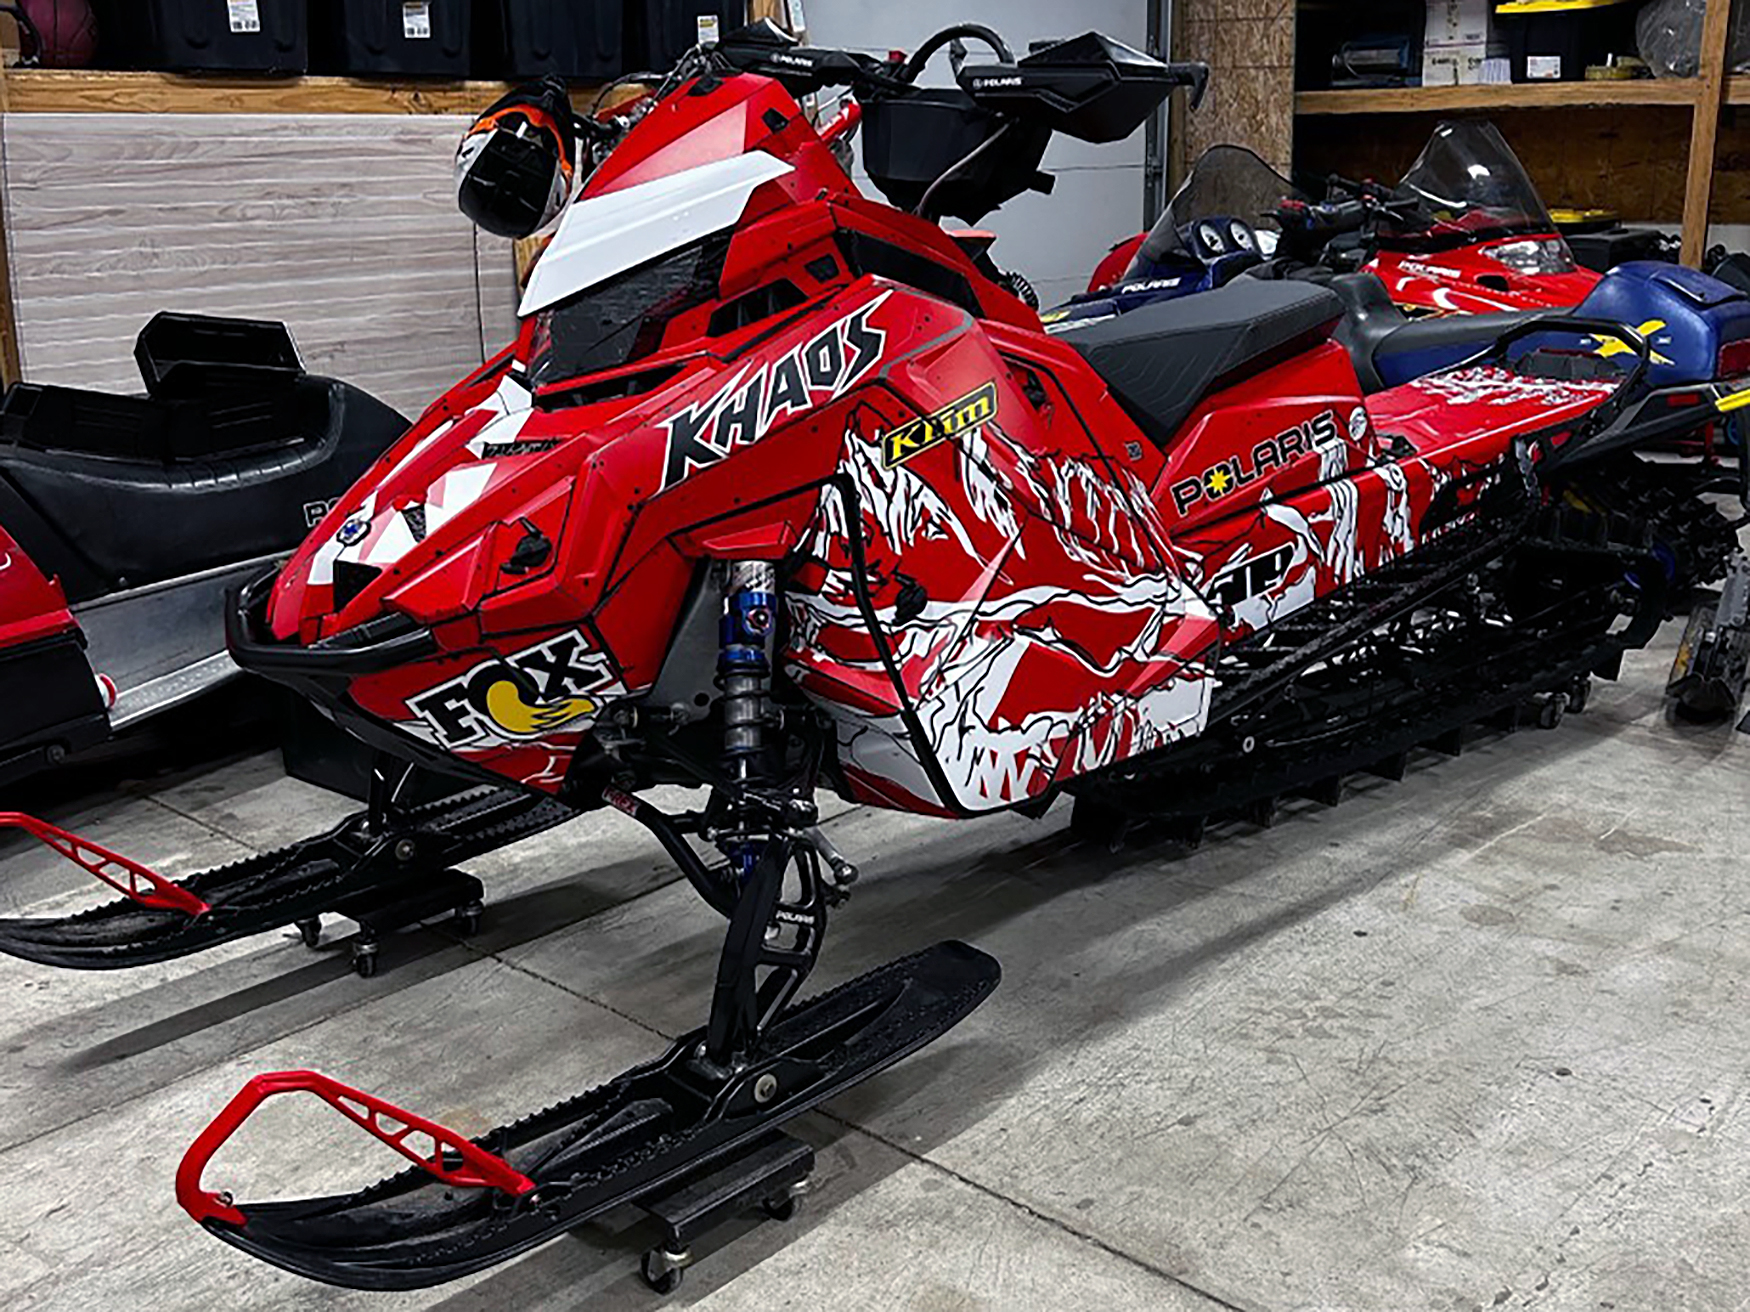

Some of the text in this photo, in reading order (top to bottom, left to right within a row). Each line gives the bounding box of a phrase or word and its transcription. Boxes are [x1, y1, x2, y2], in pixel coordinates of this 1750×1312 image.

[649, 289, 893, 498] KHAOS
[1170, 409, 1338, 518] POLARIS
[405, 628, 614, 748] FOX
